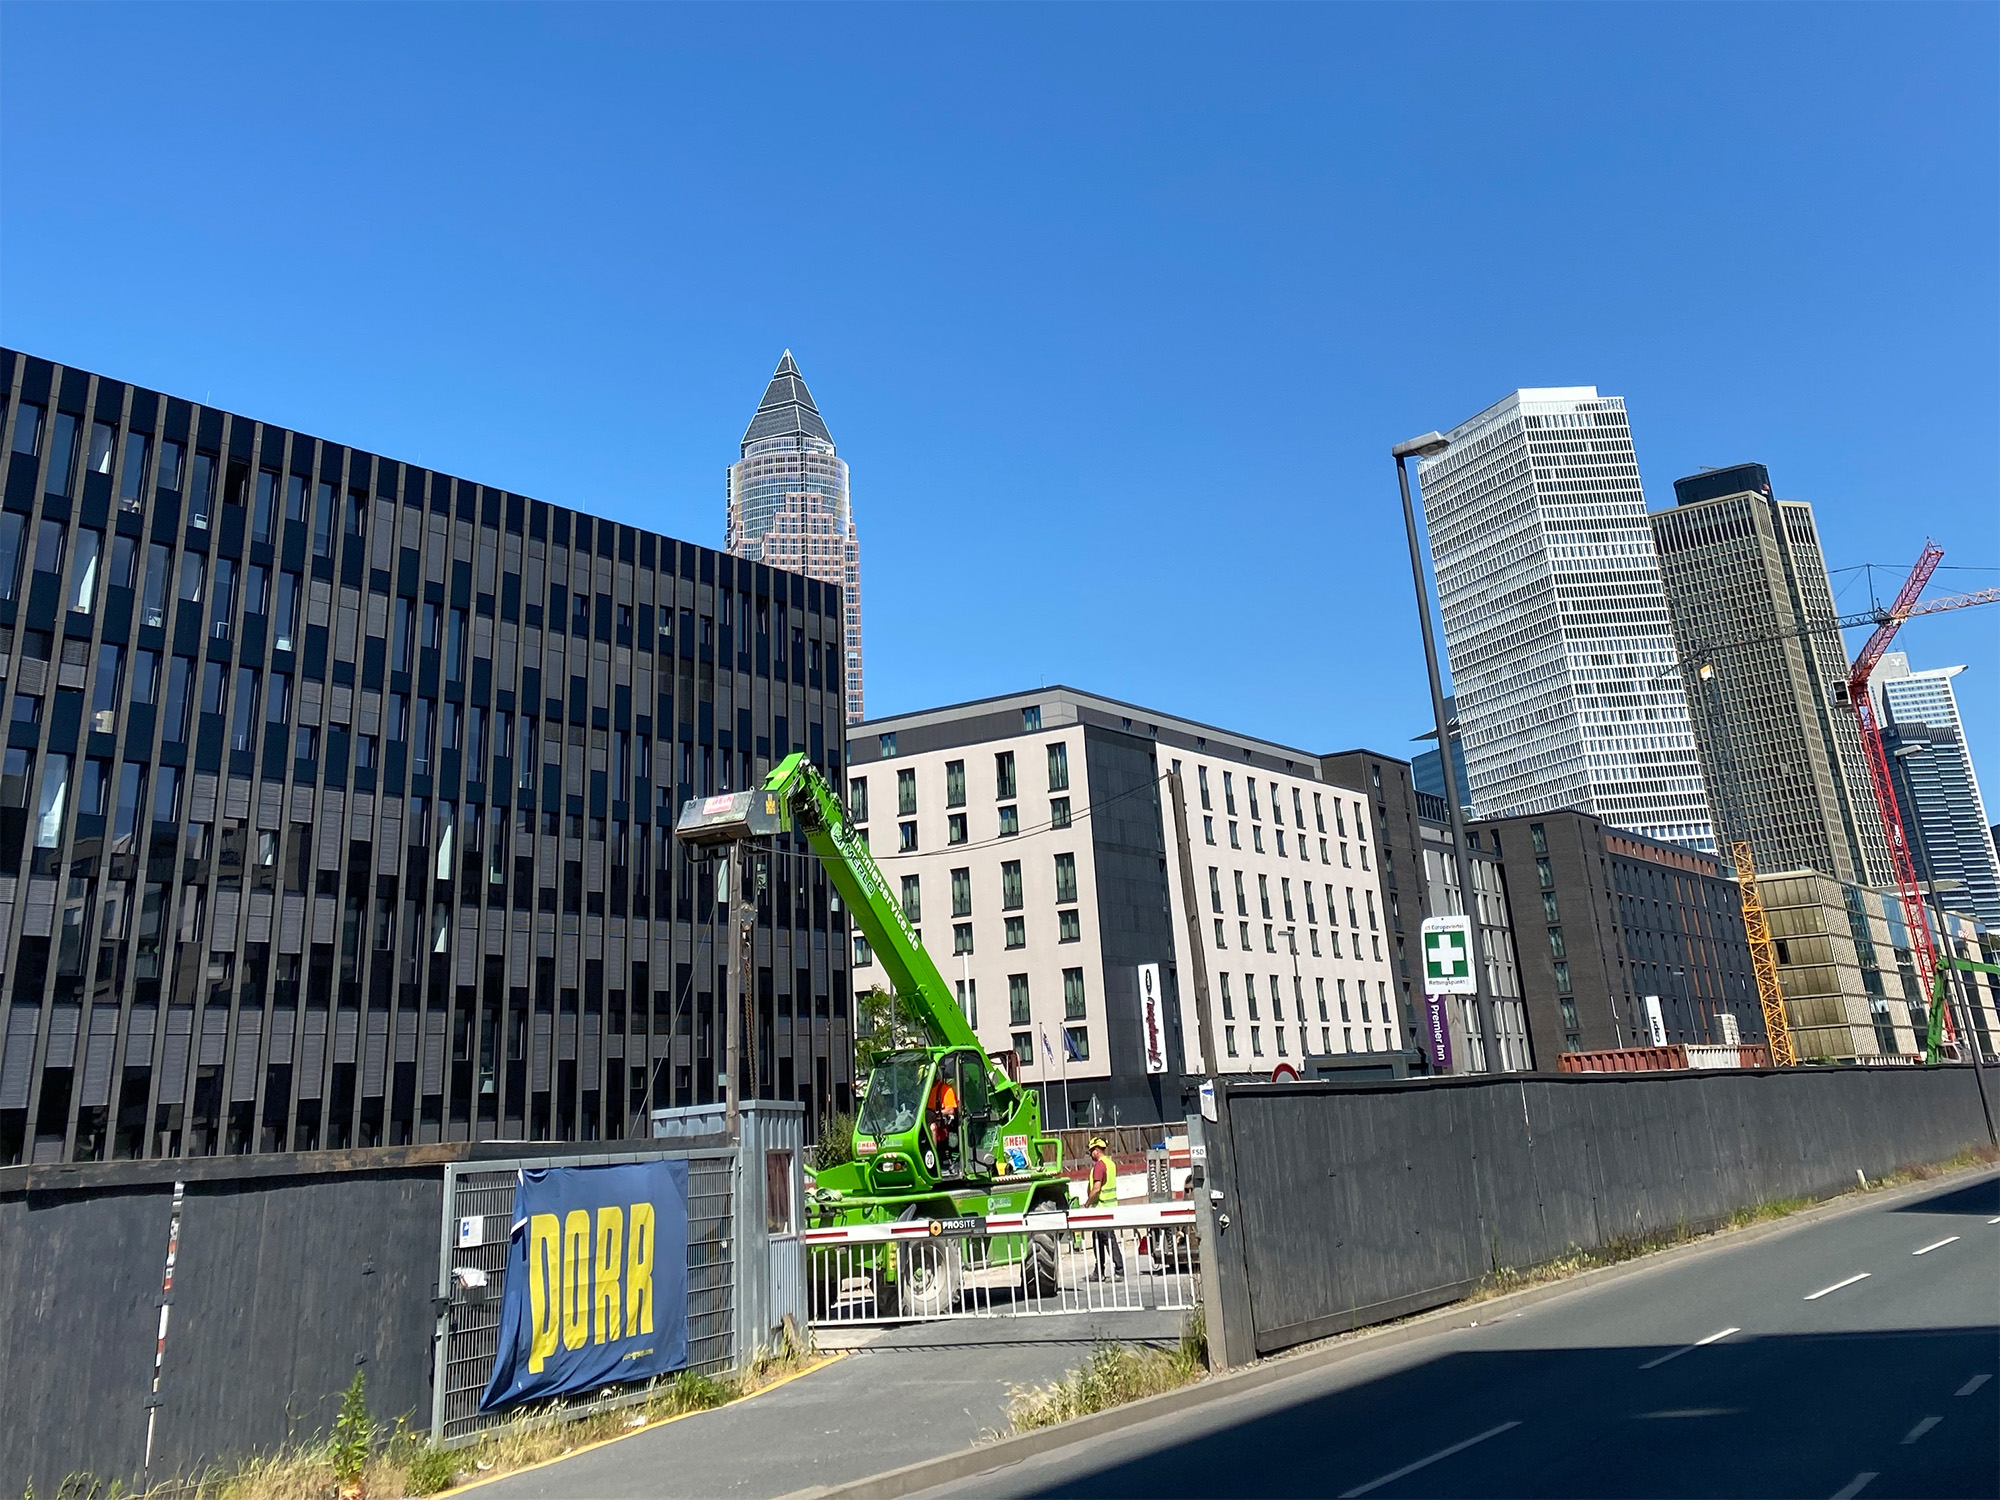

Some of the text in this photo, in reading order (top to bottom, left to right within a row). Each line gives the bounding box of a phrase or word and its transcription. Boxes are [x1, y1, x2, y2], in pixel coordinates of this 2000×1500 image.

[1146, 996, 1163, 1072] Hampton
[1430, 1004, 1446, 1061] Premier Inn
[942, 1219, 976, 1230] PROSITE
[529, 1203, 655, 1374] PORR
